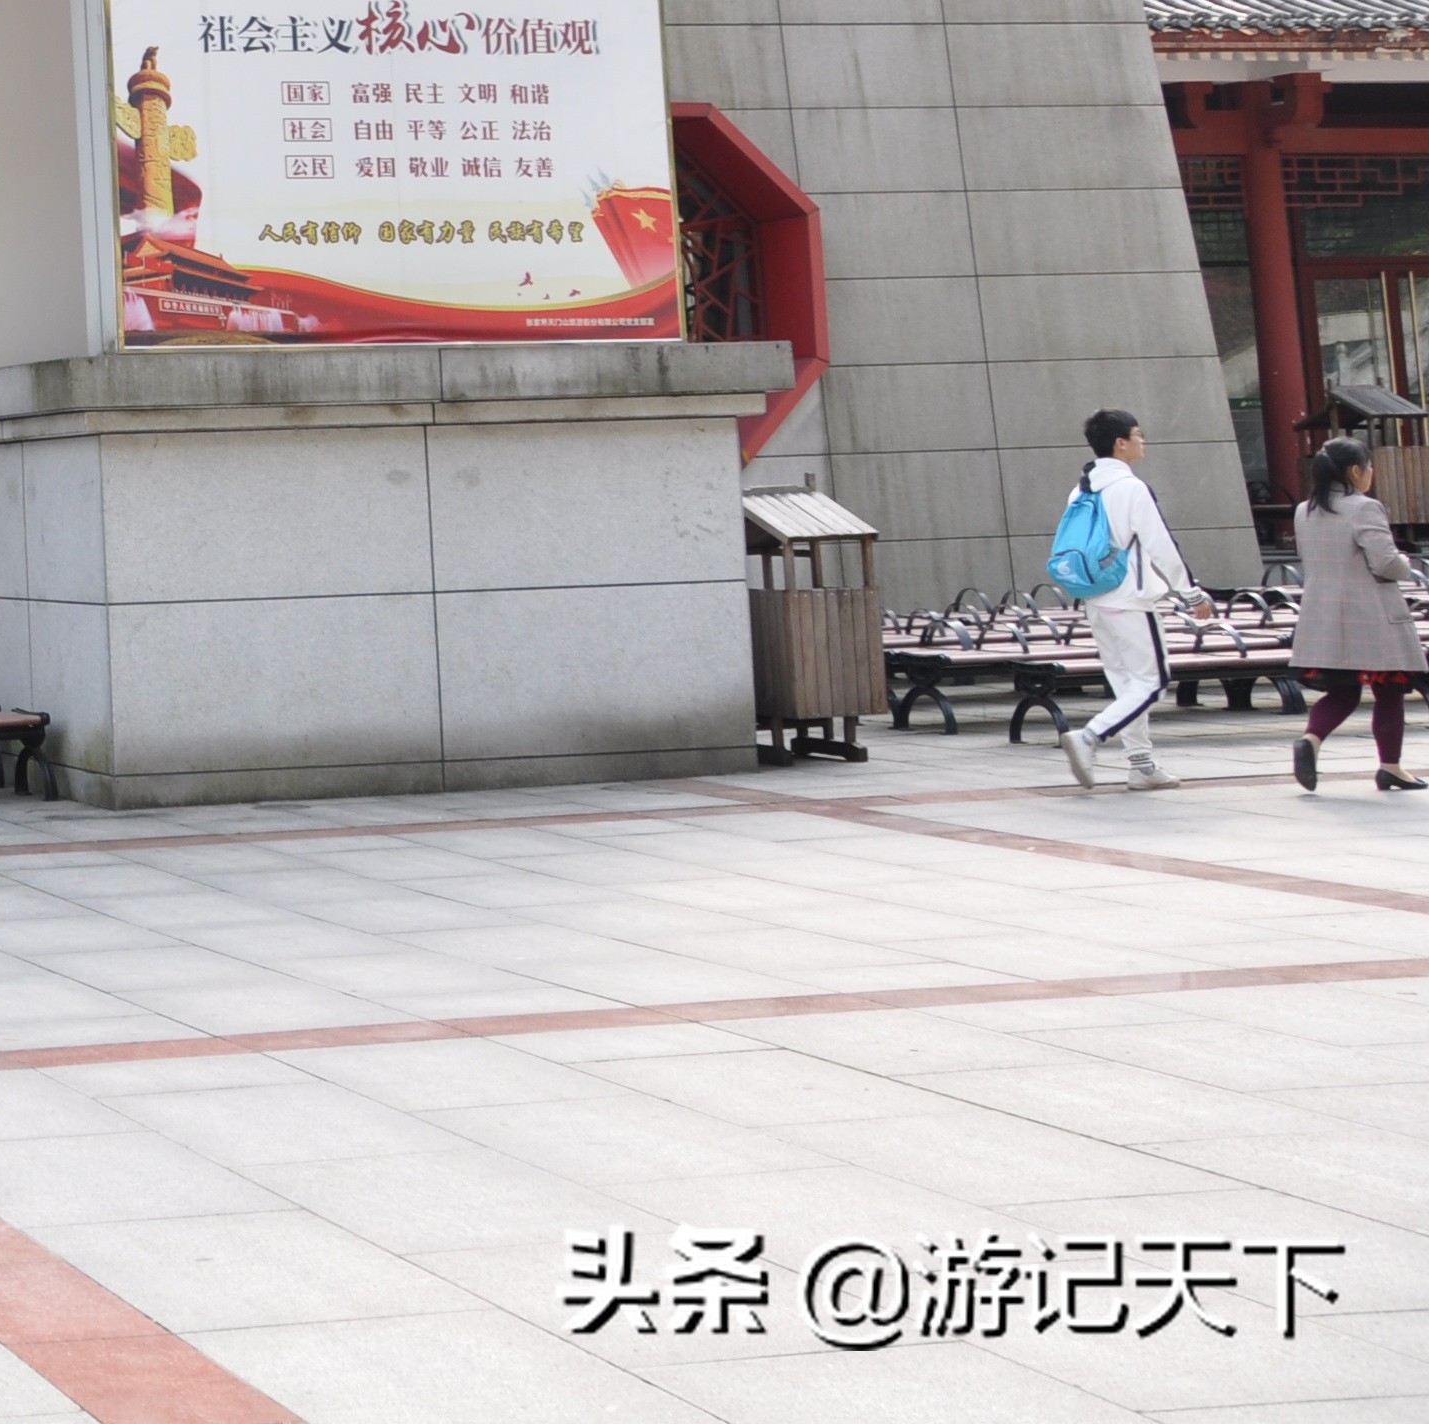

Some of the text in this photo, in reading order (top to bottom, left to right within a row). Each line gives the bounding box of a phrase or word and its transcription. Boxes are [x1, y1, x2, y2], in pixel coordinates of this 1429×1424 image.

[197, 0, 596, 55] 社会主义核心价值观
[286, 82, 550, 104] 国家 富强 民主 文明 和谐
[289, 119, 552, 141] 社会 自由 平等 公正 法治
[291, 156, 555, 178] 公民 爱国 敬业 诚信 友善
[258, 219, 585, 245] 人民有信仰 国家有力量 民族有希望
